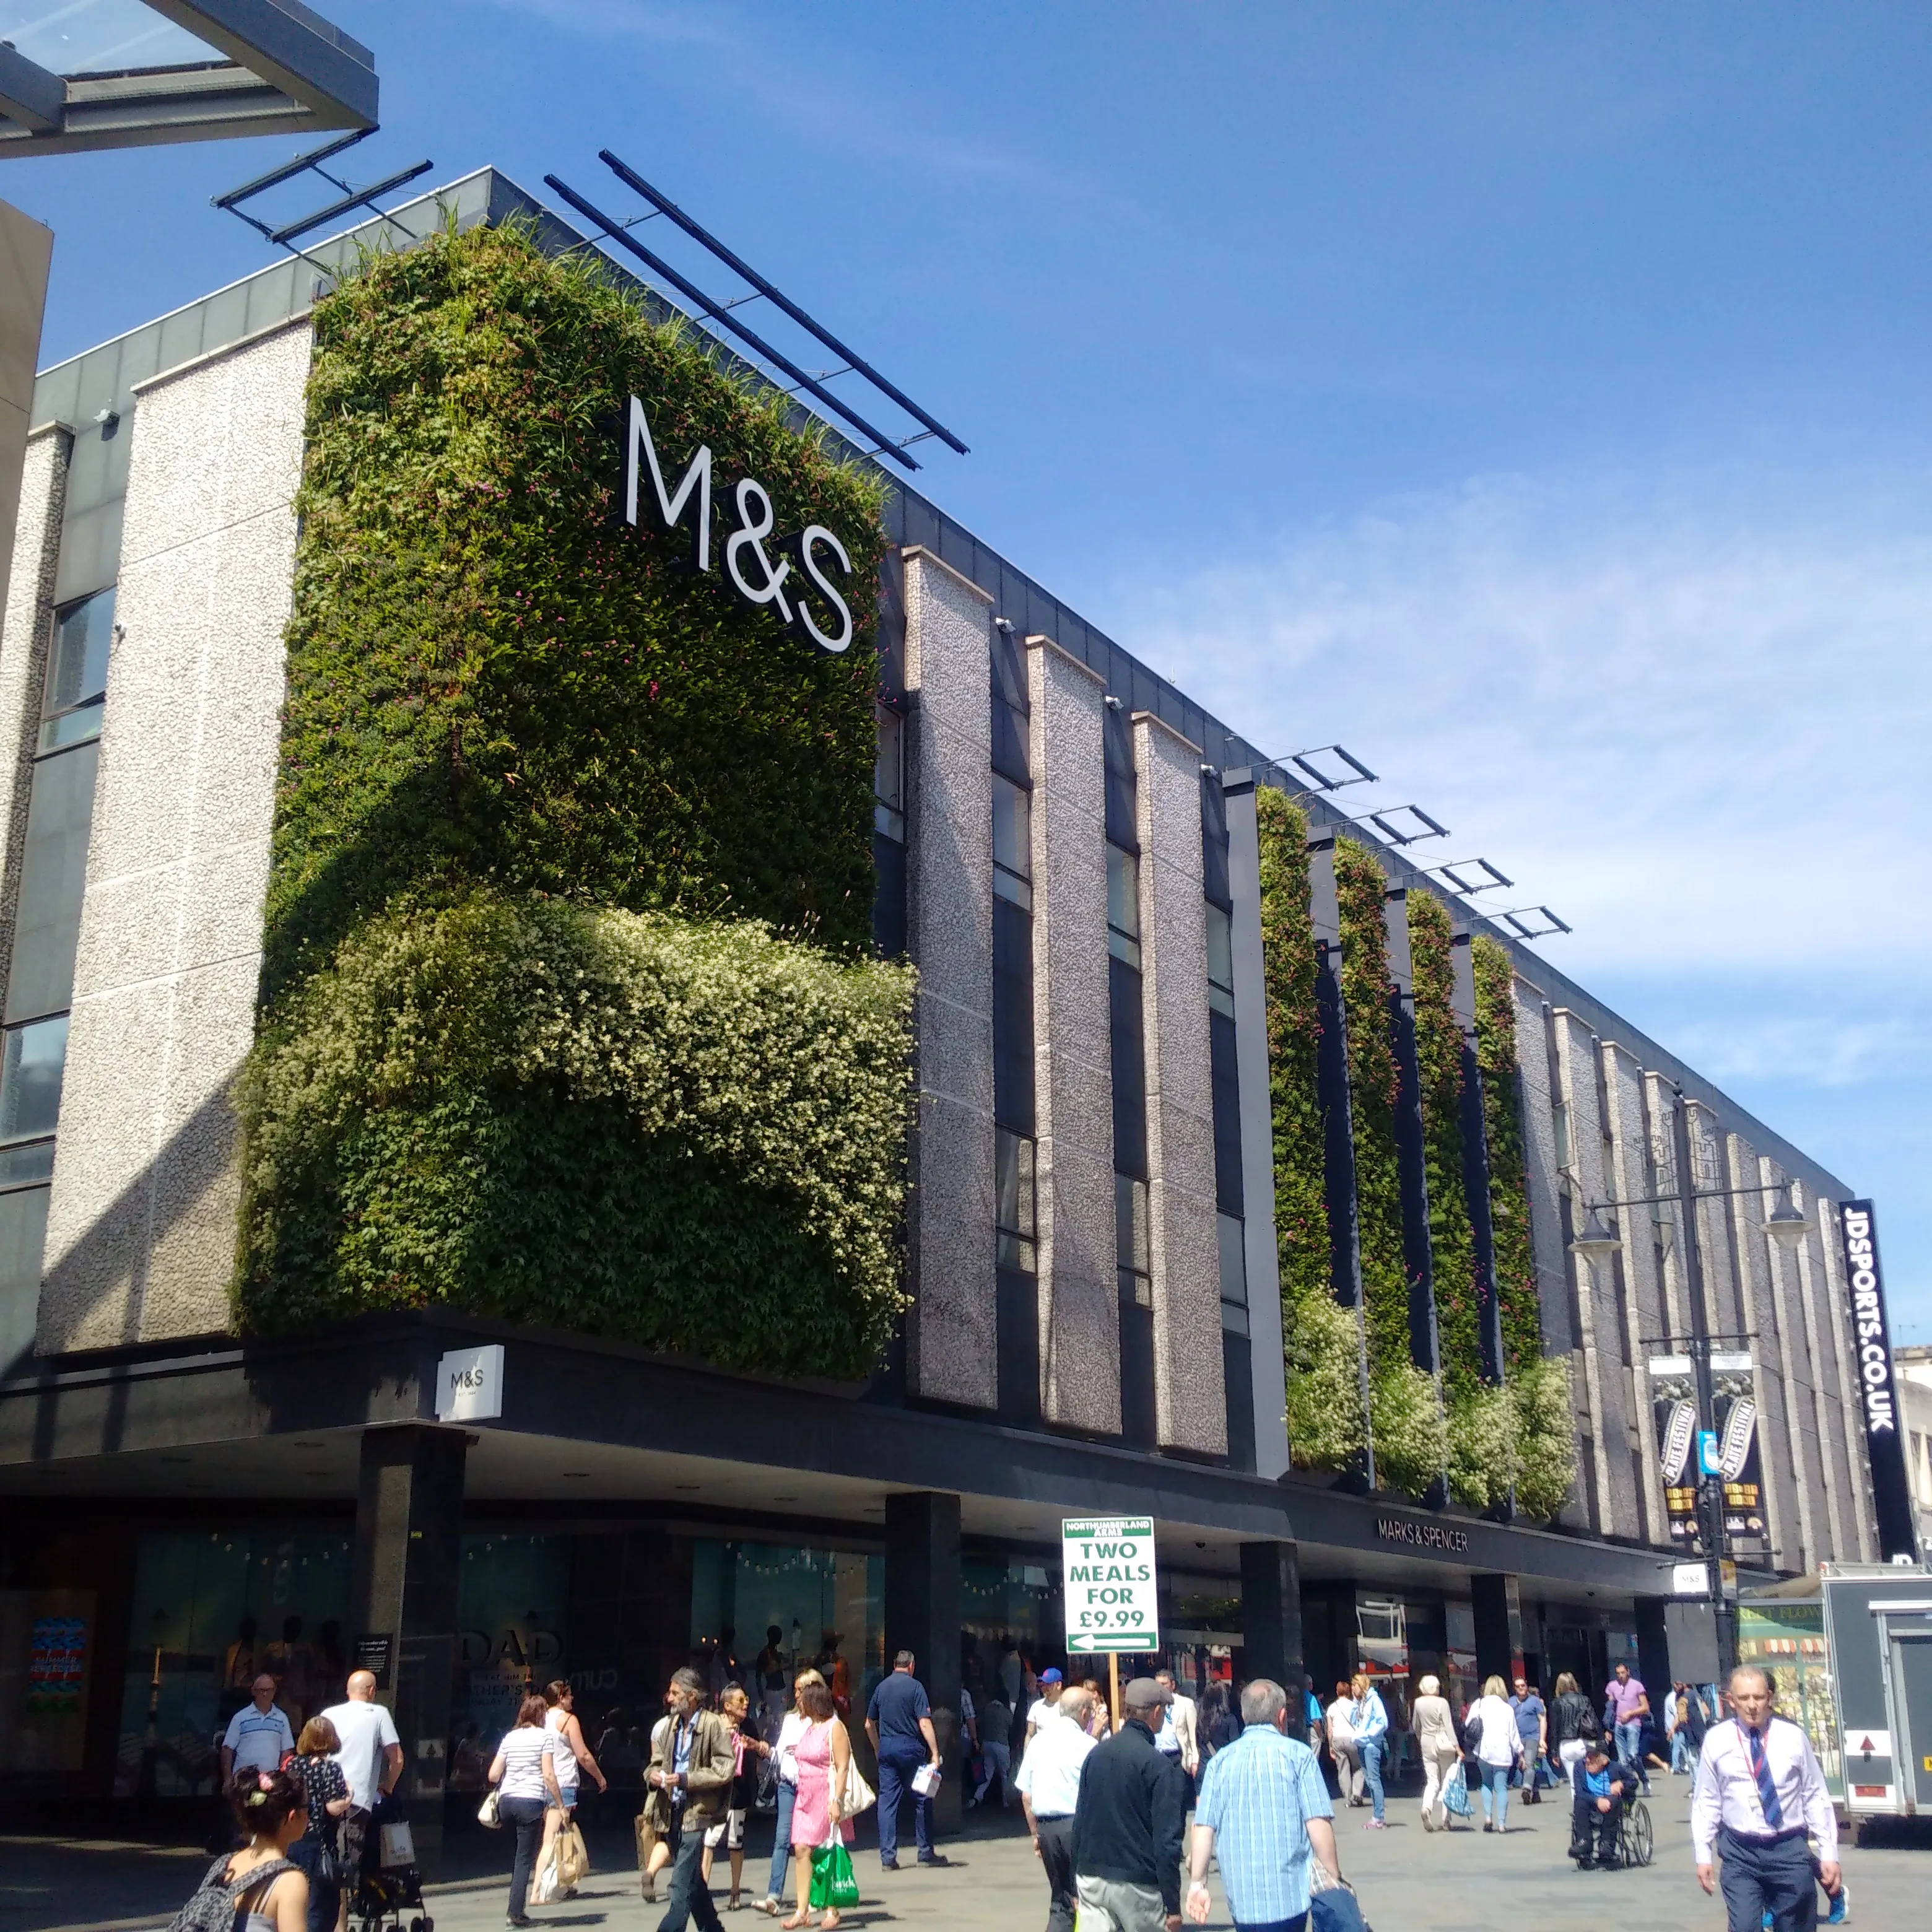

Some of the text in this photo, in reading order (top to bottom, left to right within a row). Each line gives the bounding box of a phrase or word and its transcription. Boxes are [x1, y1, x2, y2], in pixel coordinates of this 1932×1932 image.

[626, 394, 852, 652] M&S
[1845, 1207, 1894, 1432] JDSPORTS.CO.UK
[451, 1369, 484, 1389] M&S
[1730, 1401, 1754, 1447] FESTIVAL
[1664, 1448, 1682, 1478] PLATE
[1673, 1404, 1694, 1452] FESTIVAL
[1723, 1444, 1743, 1474] PLATE
[1066, 1521, 1149, 1531] NORTHUMBERLAND
[1094, 1528, 1123, 1537] ARMS
[1080, 1543, 1138, 1559] TWO
[1069, 1565, 1151, 1582] MEALS
[1087, 1588, 1134, 1604] FOR
[1079, 1610, 1144, 1627] £9.99
